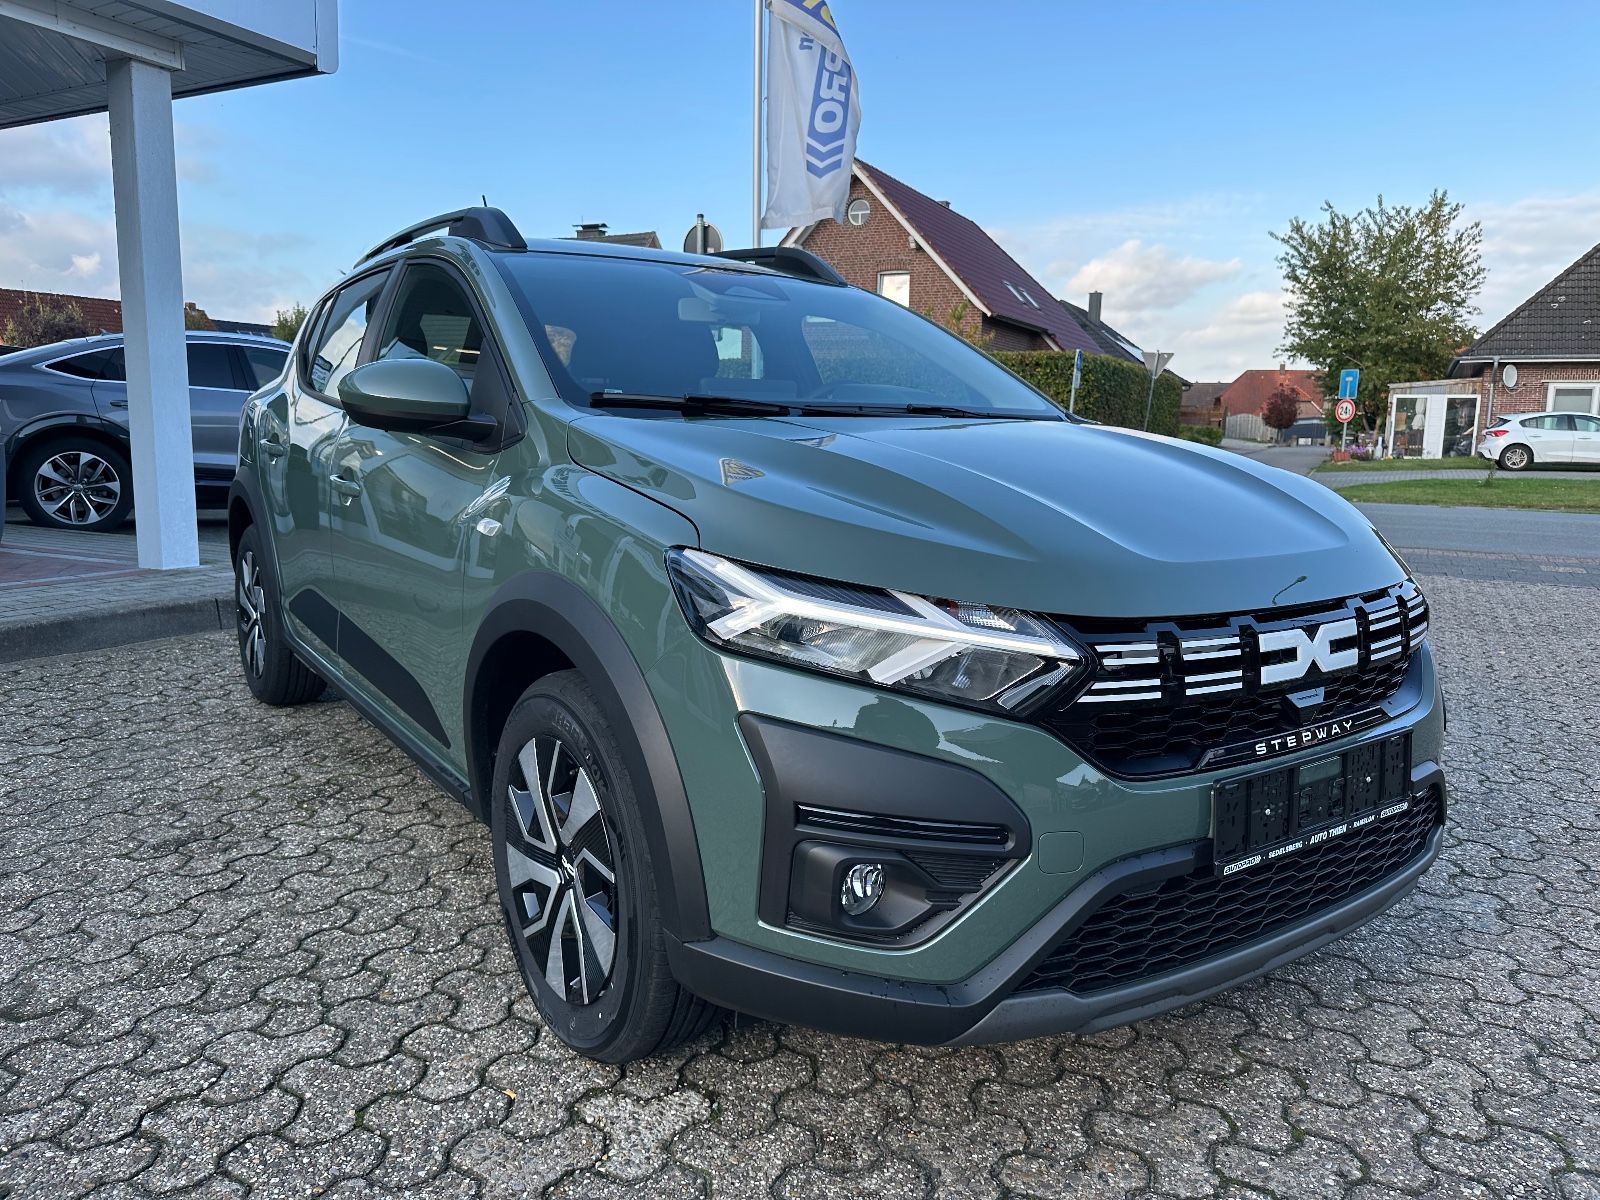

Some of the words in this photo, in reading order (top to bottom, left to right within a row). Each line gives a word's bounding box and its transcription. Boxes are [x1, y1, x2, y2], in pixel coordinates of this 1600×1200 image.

[1255, 719, 1353, 755] STEPWAY
[1268, 841, 1303, 858] SEDELSBERG
[1309, 831, 1328, 844] AUTO
[1329, 824, 1348, 837] THIEN
